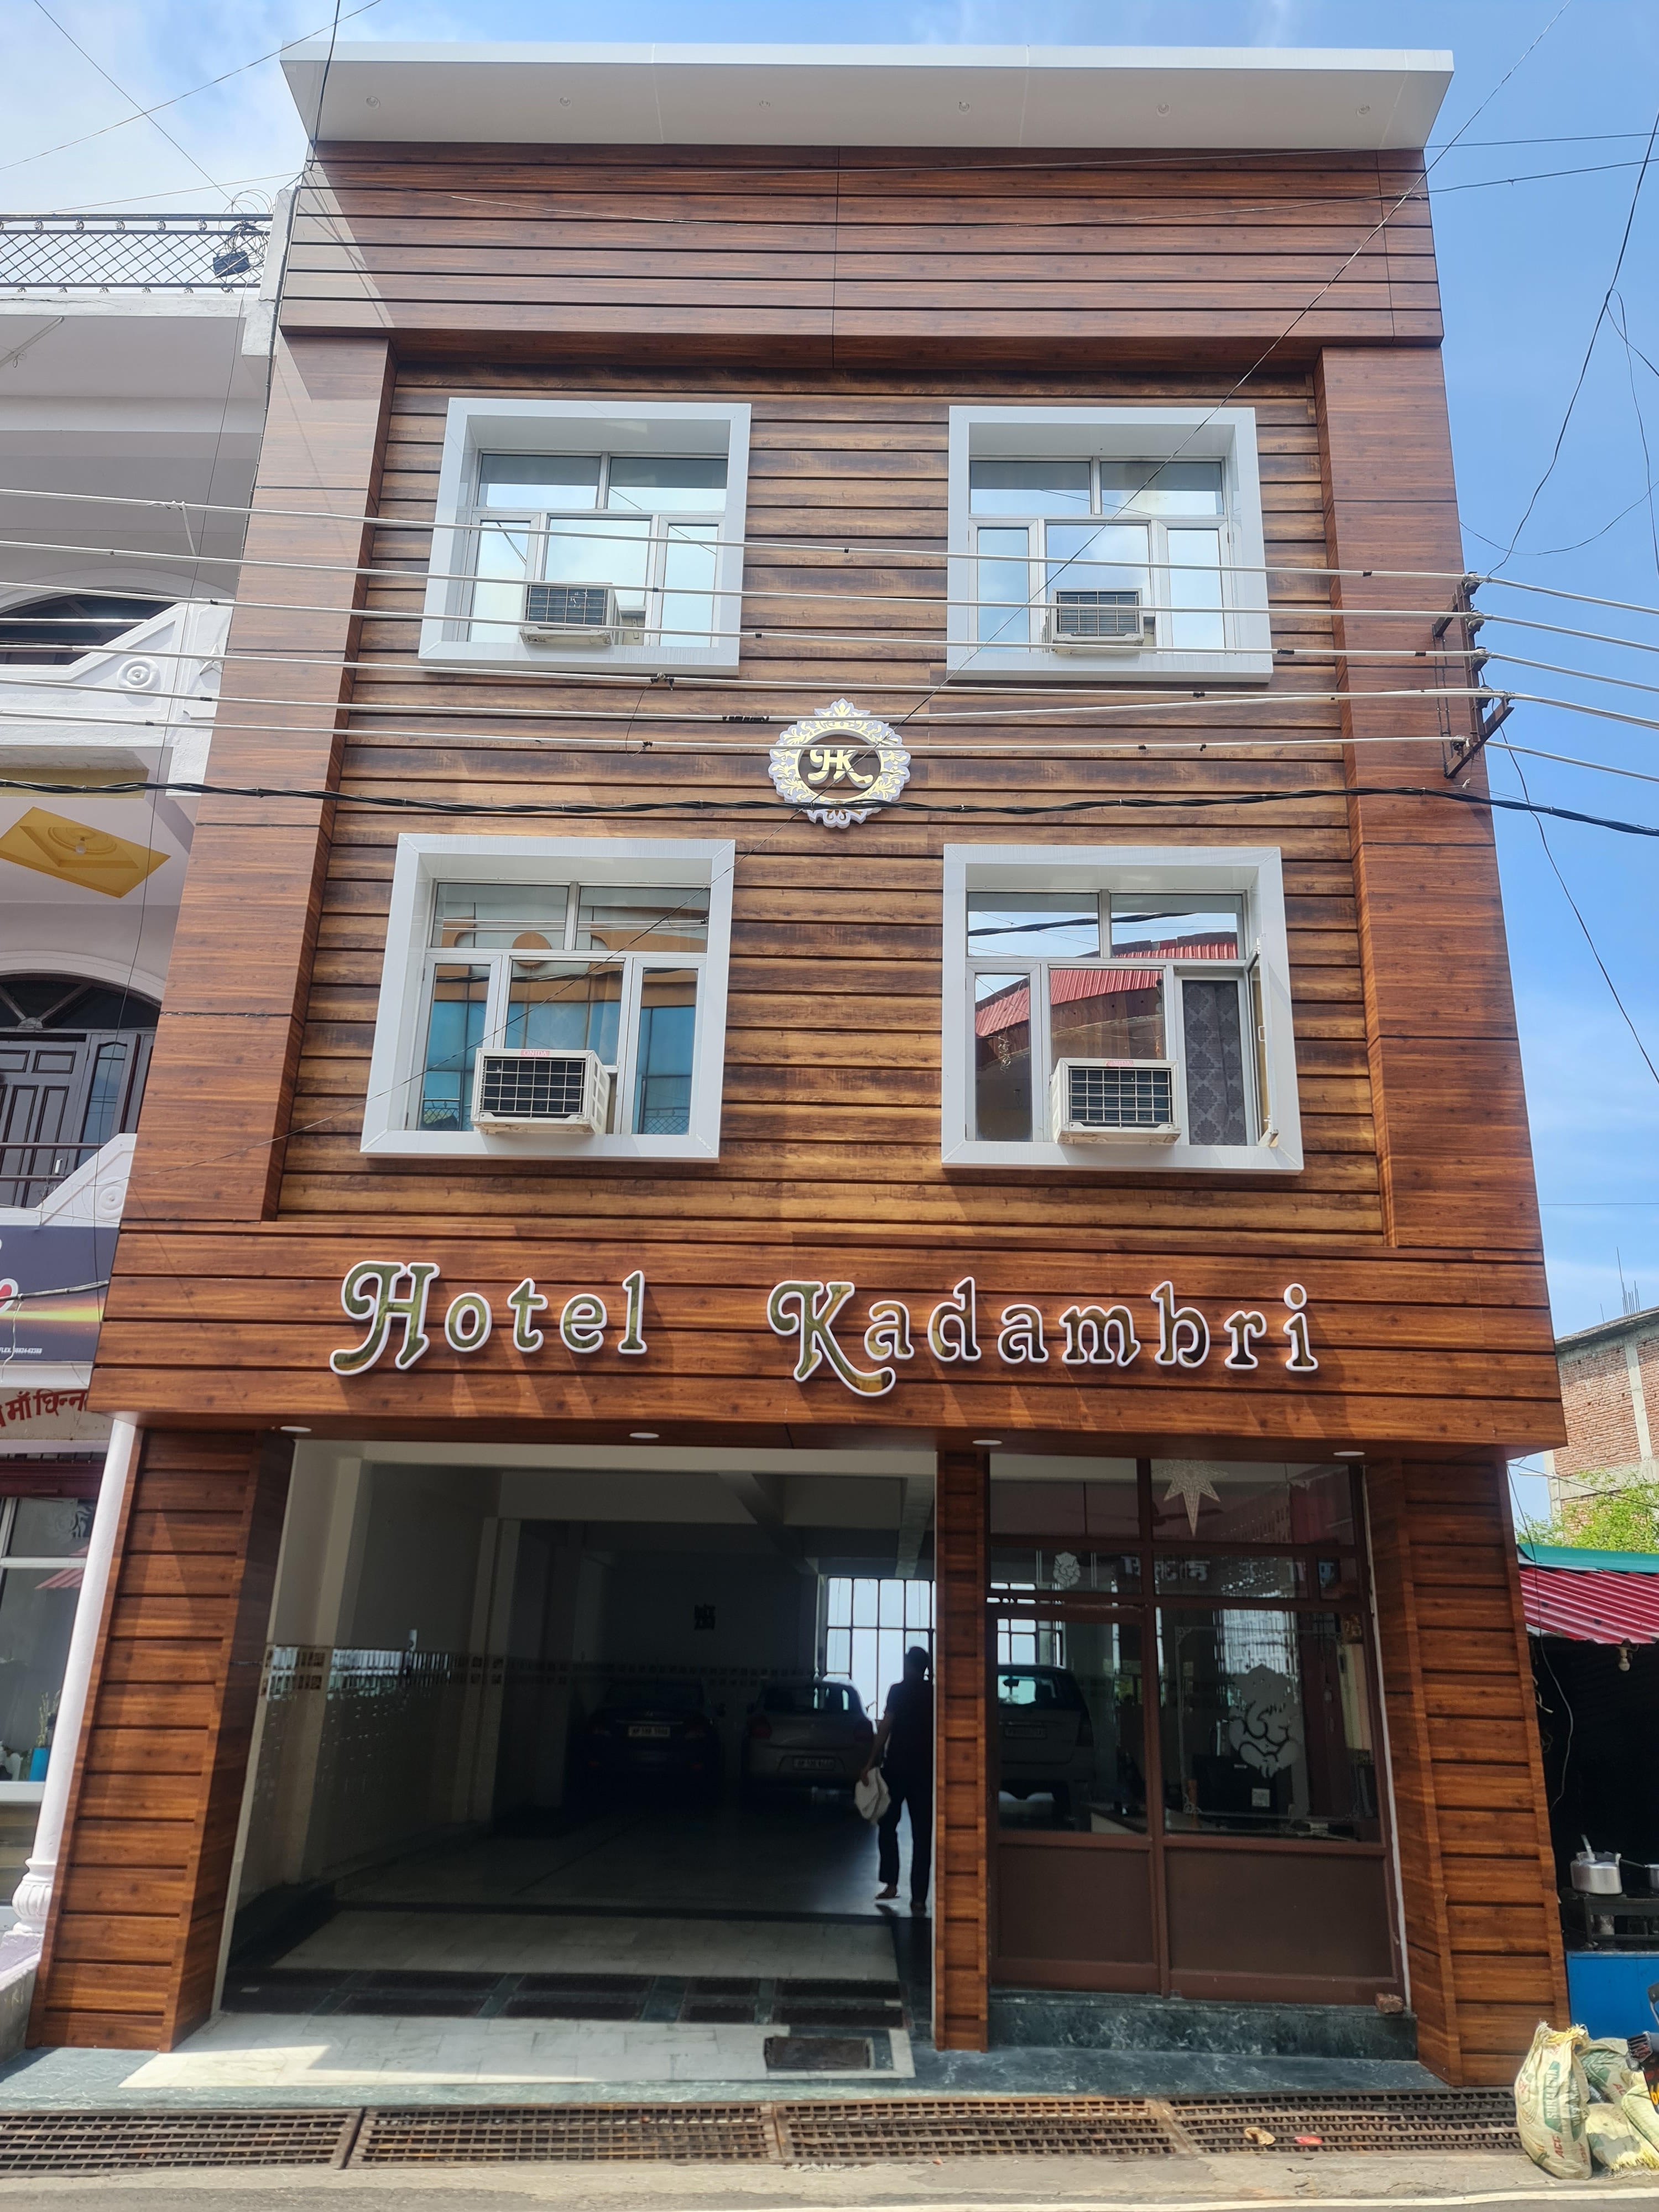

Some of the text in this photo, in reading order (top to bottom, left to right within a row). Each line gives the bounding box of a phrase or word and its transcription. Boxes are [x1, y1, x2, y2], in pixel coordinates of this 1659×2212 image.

[329, 1260, 1318, 1397] Hotel Kadambri
[1552, 2135, 1565, 2159] ACC
